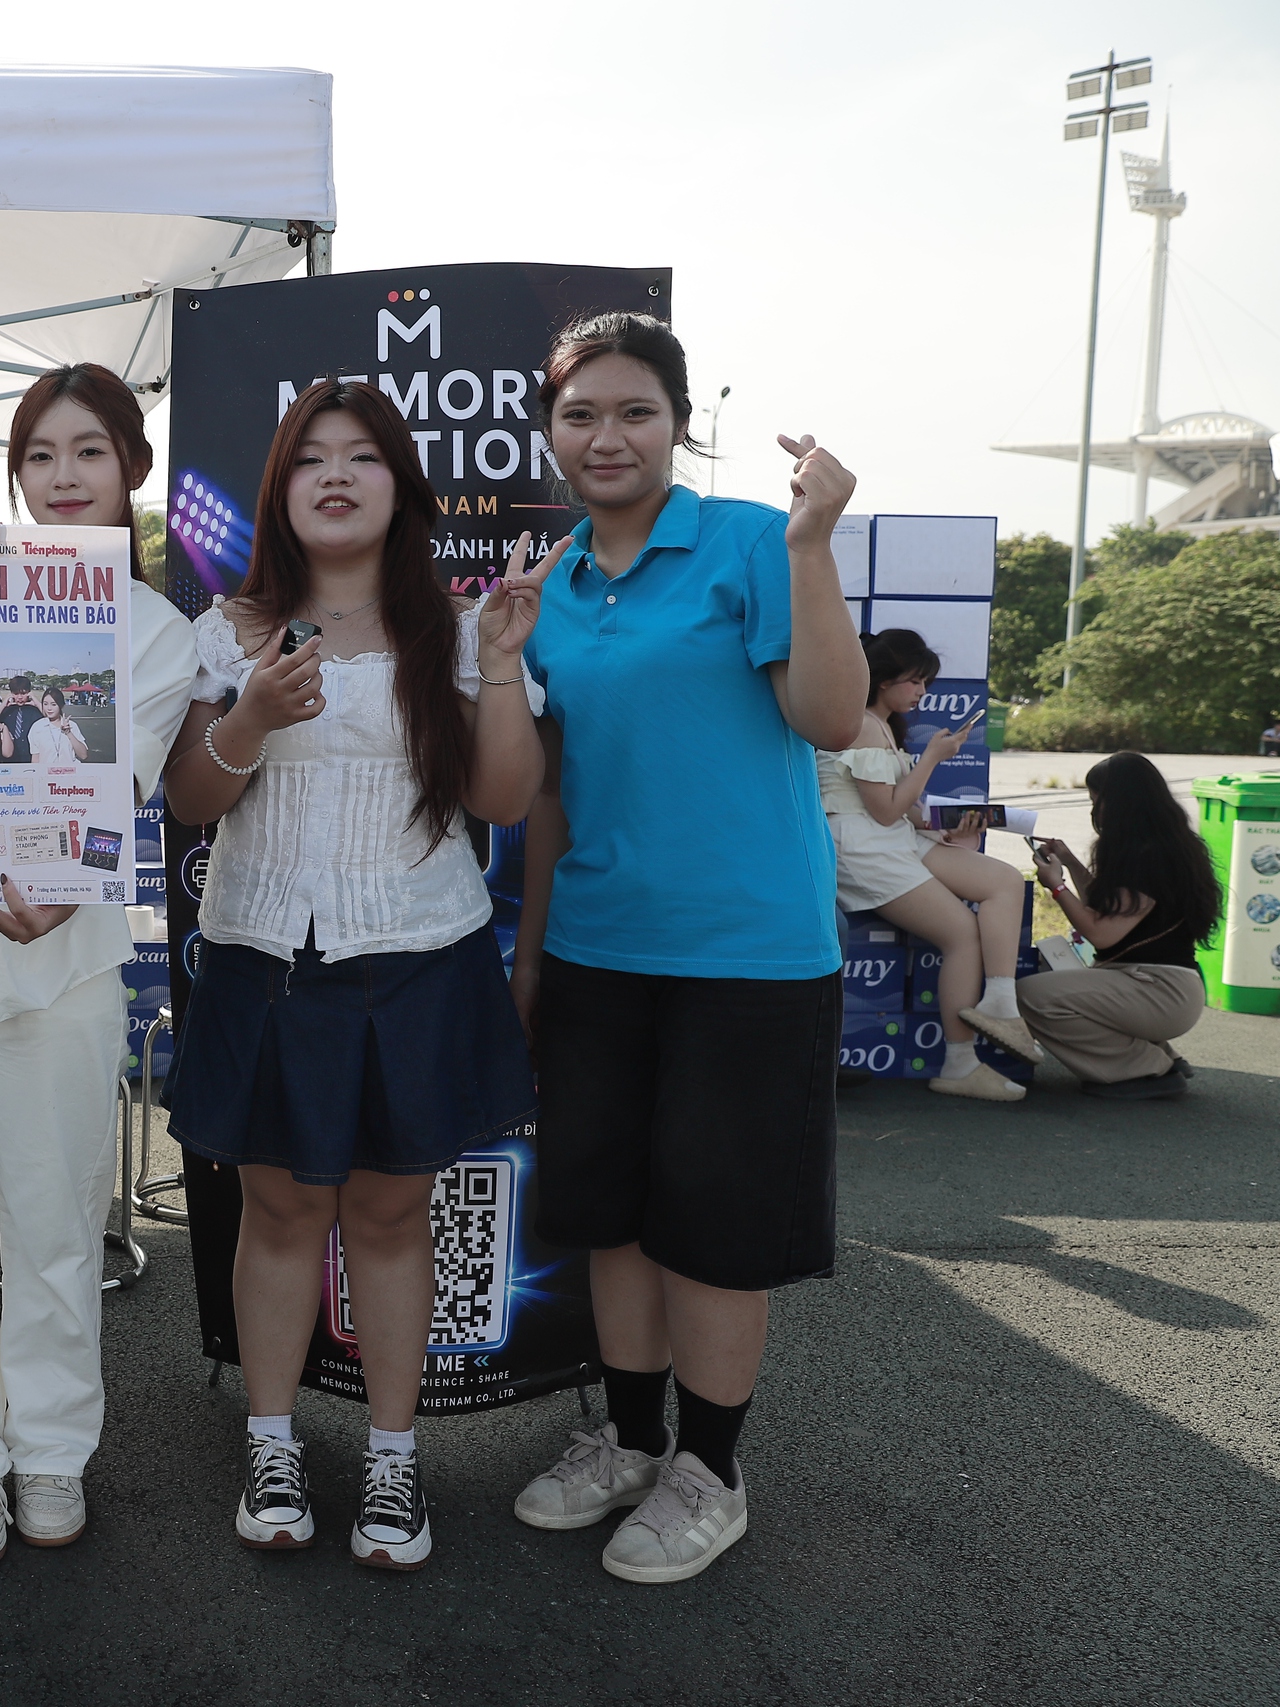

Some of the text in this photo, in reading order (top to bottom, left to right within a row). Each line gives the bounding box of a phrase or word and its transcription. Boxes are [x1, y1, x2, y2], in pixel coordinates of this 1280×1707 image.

[410, 429, 567, 481] TION
[23, 561, 115, 602] XUÂN
[25, 605, 79, 625] TRANG
[86, 603, 116, 625] BÁO
[909, 692, 980, 720] any
[62, 805, 87, 817] Phong
[134, 808, 164, 823] any
[321, 1358, 510, 1387] CONNEC RIENCE SHARE
[436, 1354, 466, 1372] ME
[320, 1375, 517, 1408] MEMORY VIETNAM CO., LTD.
